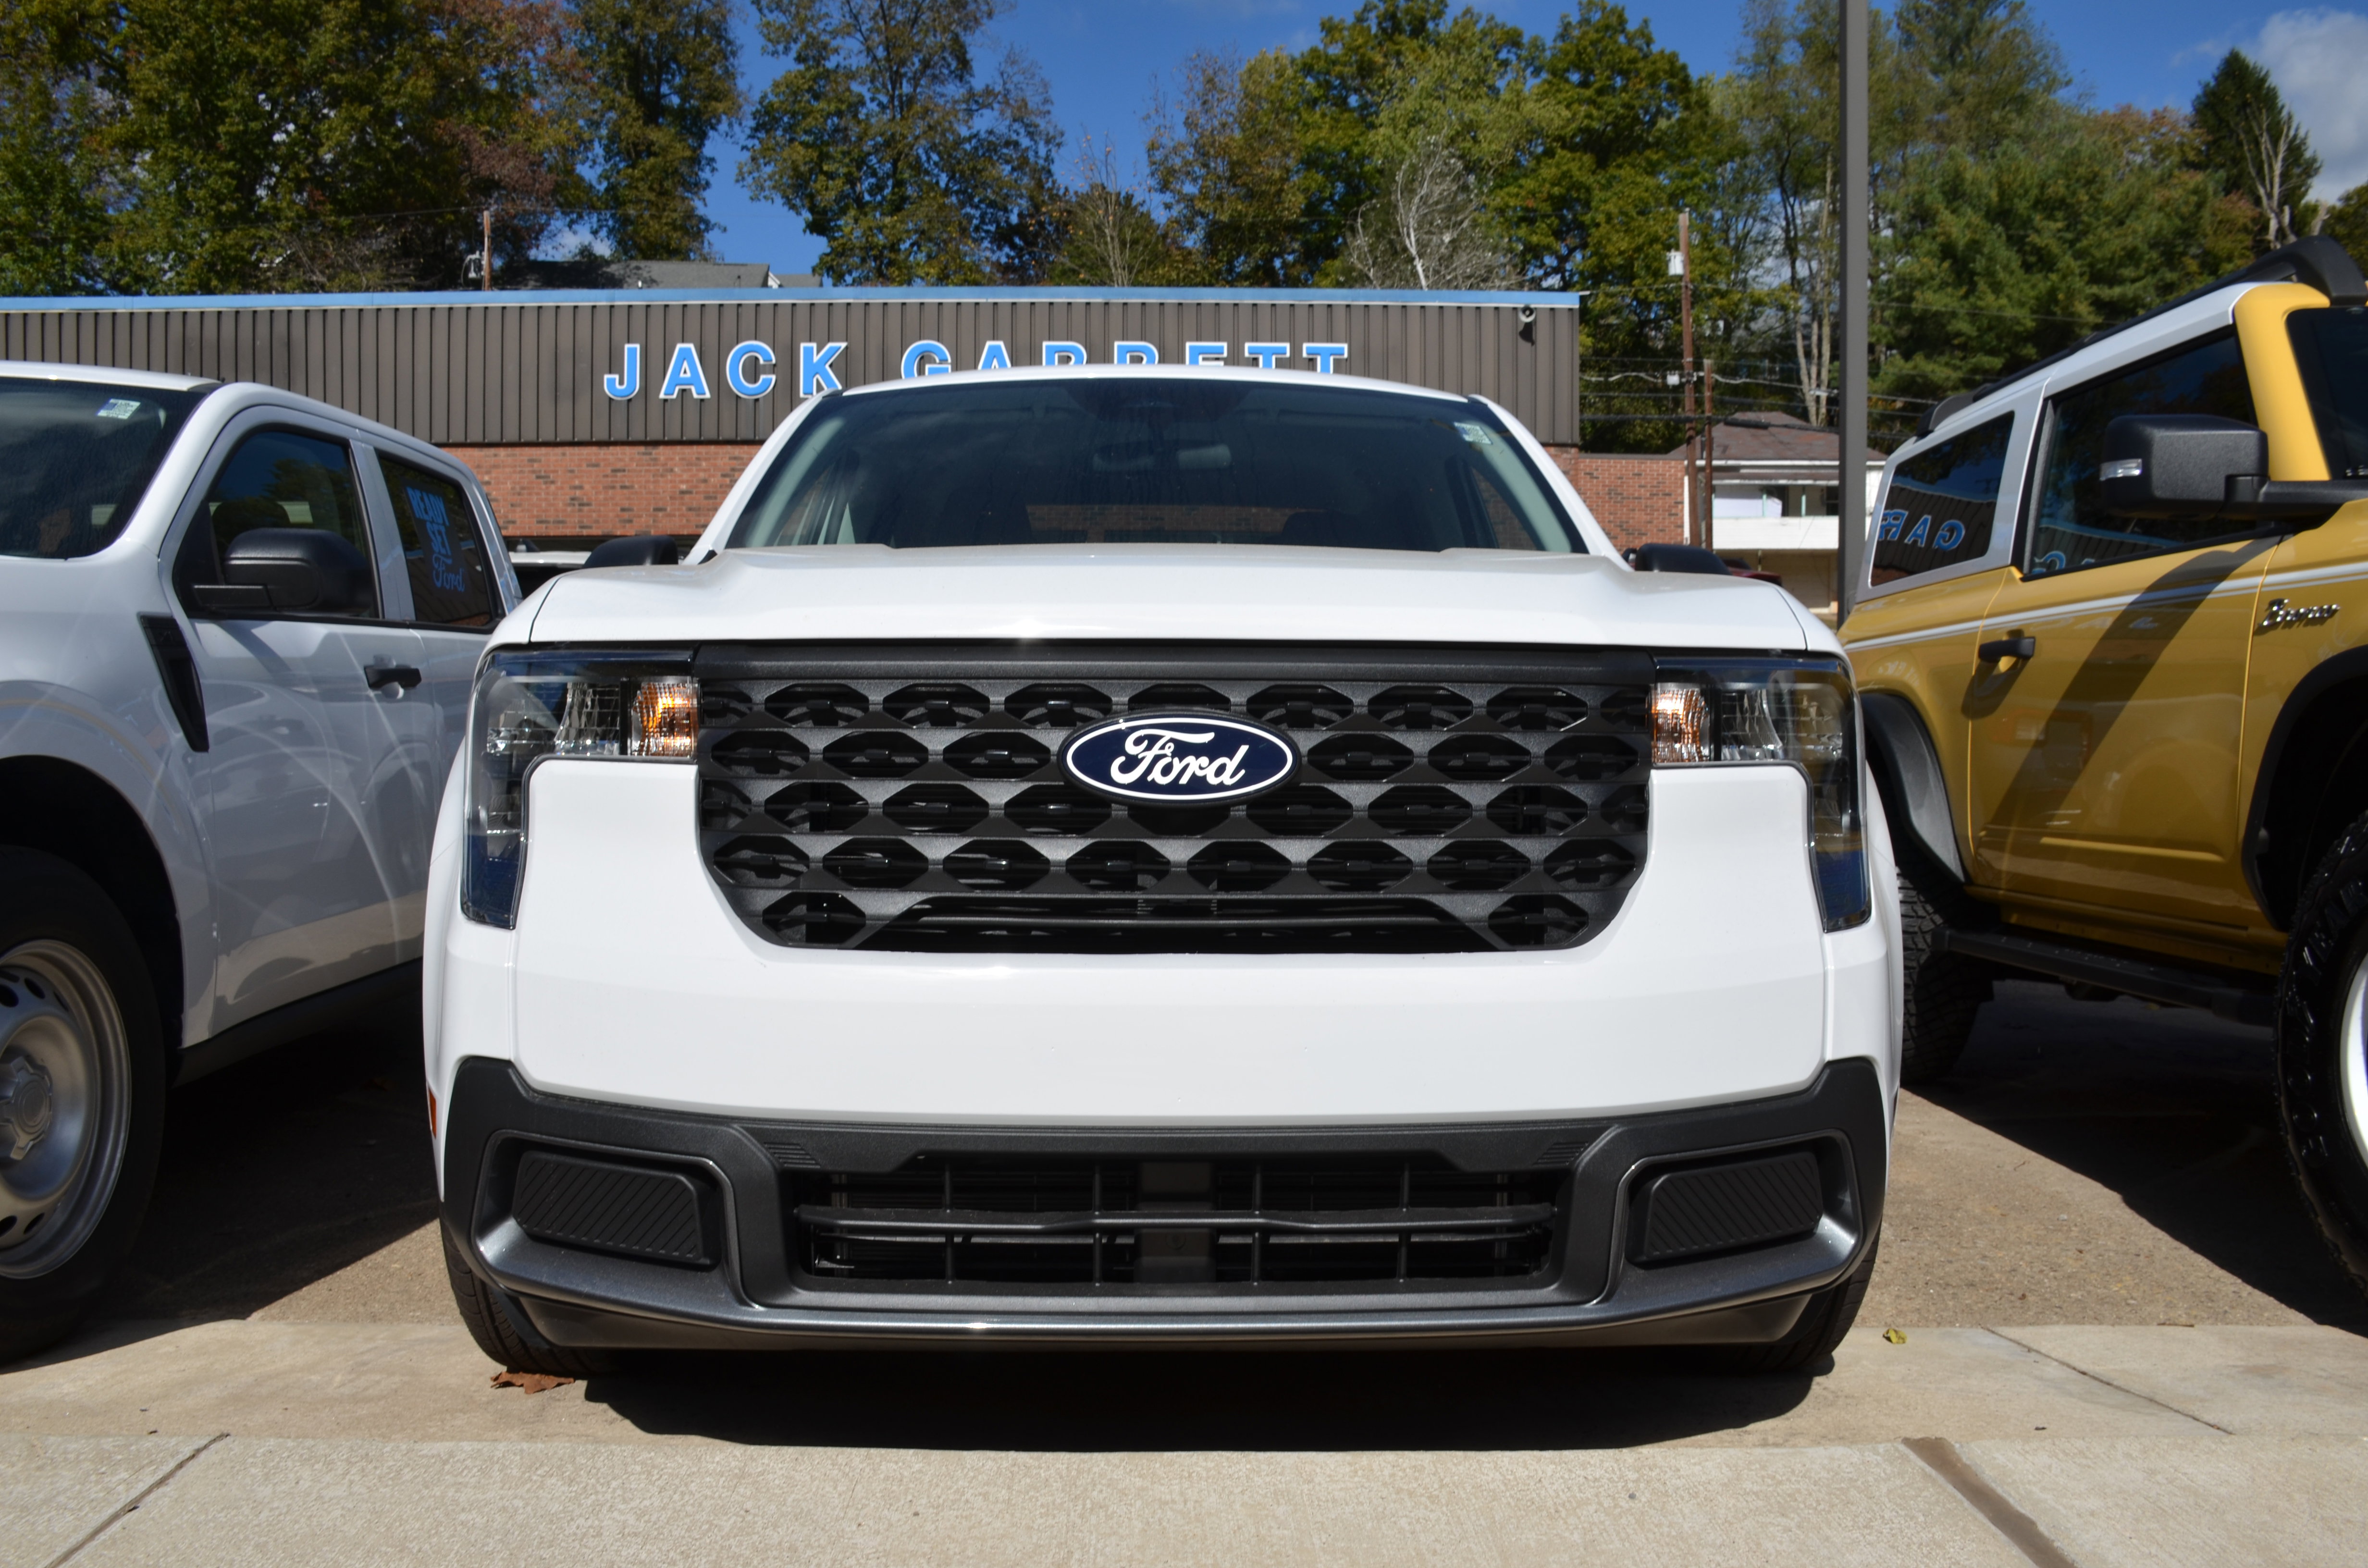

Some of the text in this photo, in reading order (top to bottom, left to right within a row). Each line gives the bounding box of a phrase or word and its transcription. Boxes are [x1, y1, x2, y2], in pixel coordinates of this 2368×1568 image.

[604, 340, 848, 400] JACK
[406, 486, 450, 527] READY
[425, 519, 452, 556] SET
[432, 552, 465, 592] Ford
[1110, 728, 1249, 785] Ford
